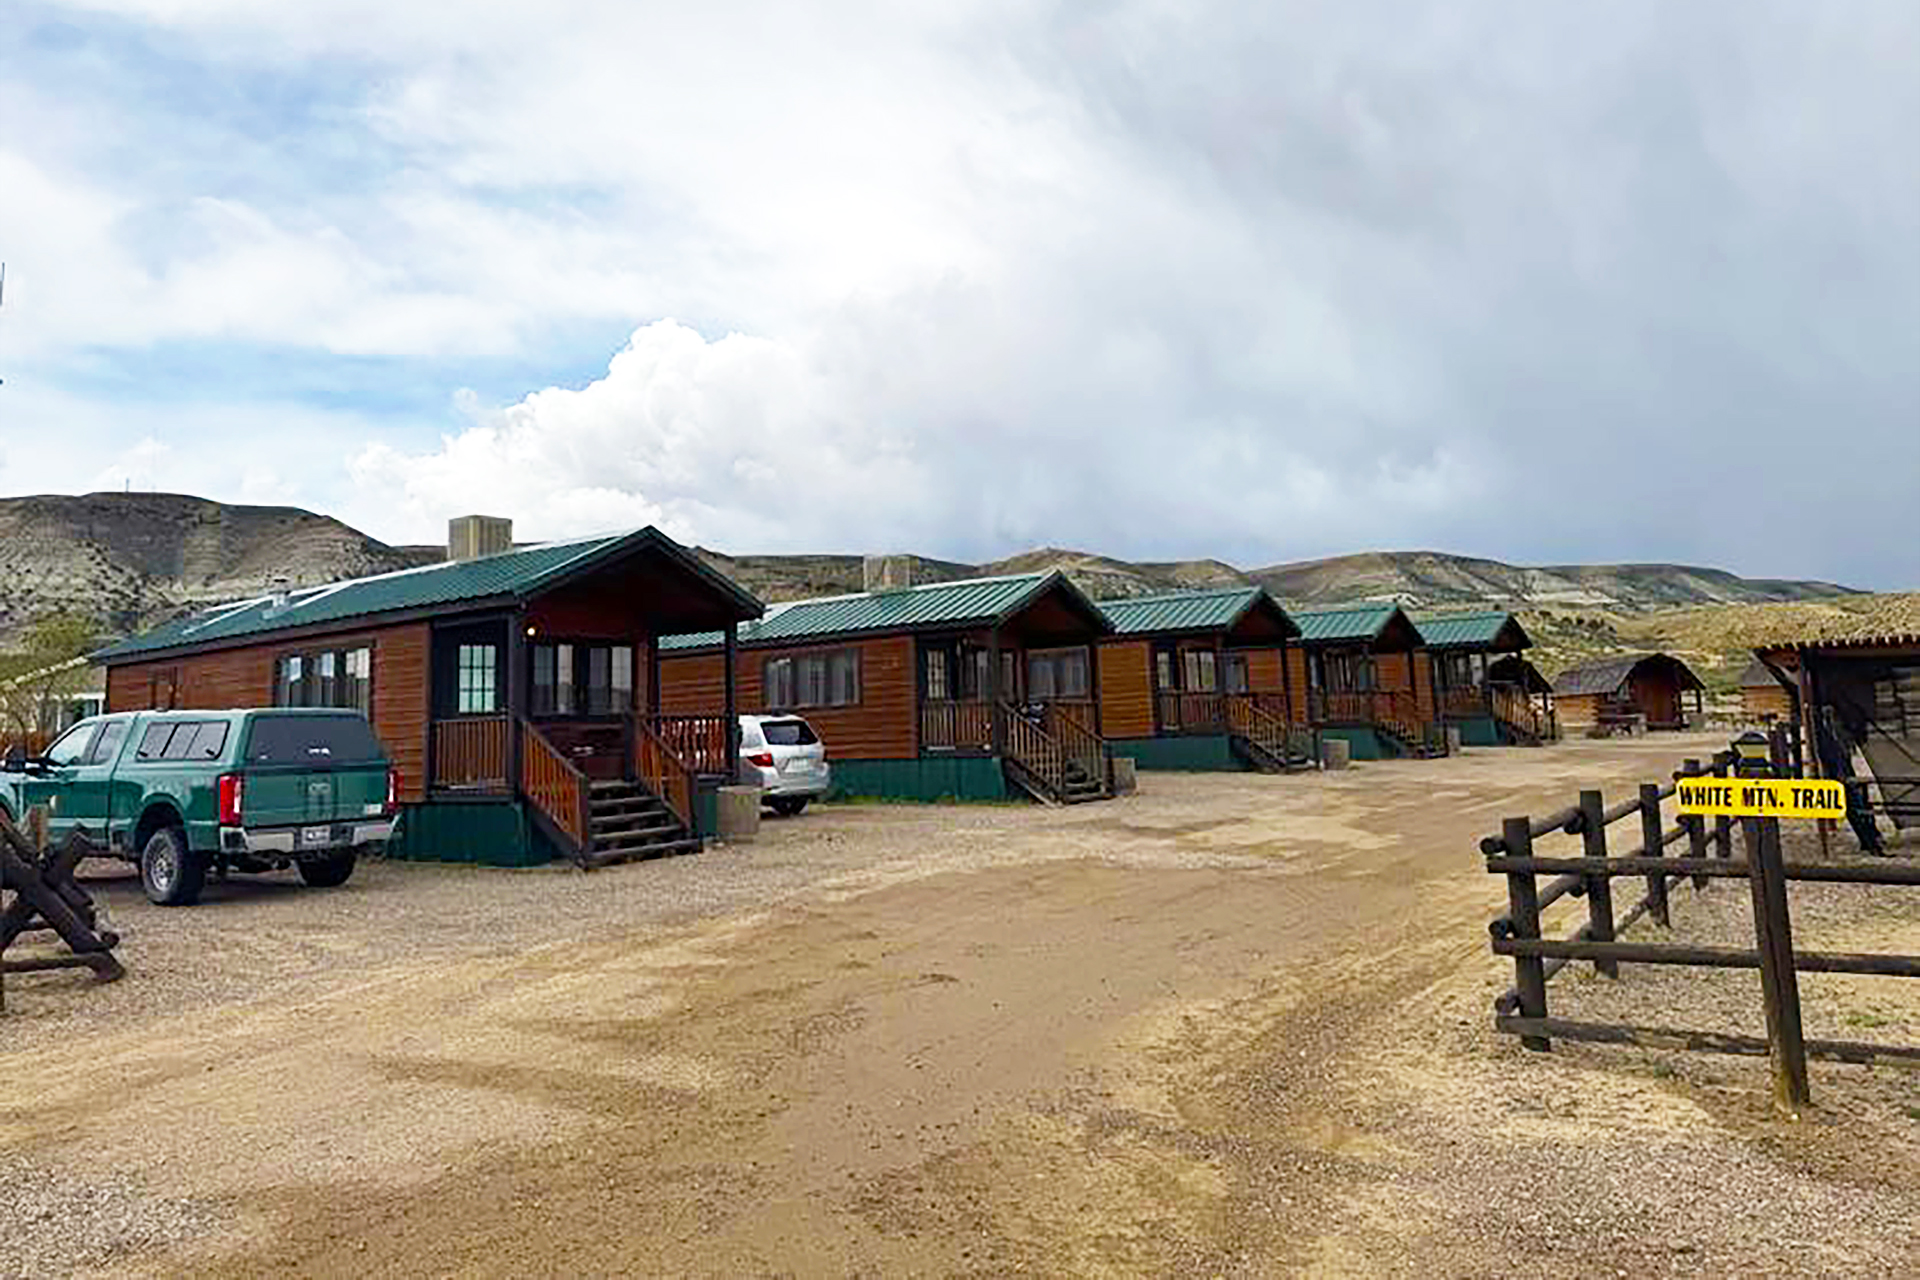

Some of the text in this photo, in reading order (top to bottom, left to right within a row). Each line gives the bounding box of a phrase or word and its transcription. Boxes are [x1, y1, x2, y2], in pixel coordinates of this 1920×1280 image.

[1679, 786, 1843, 810] WHITE MTN. TRAIL
